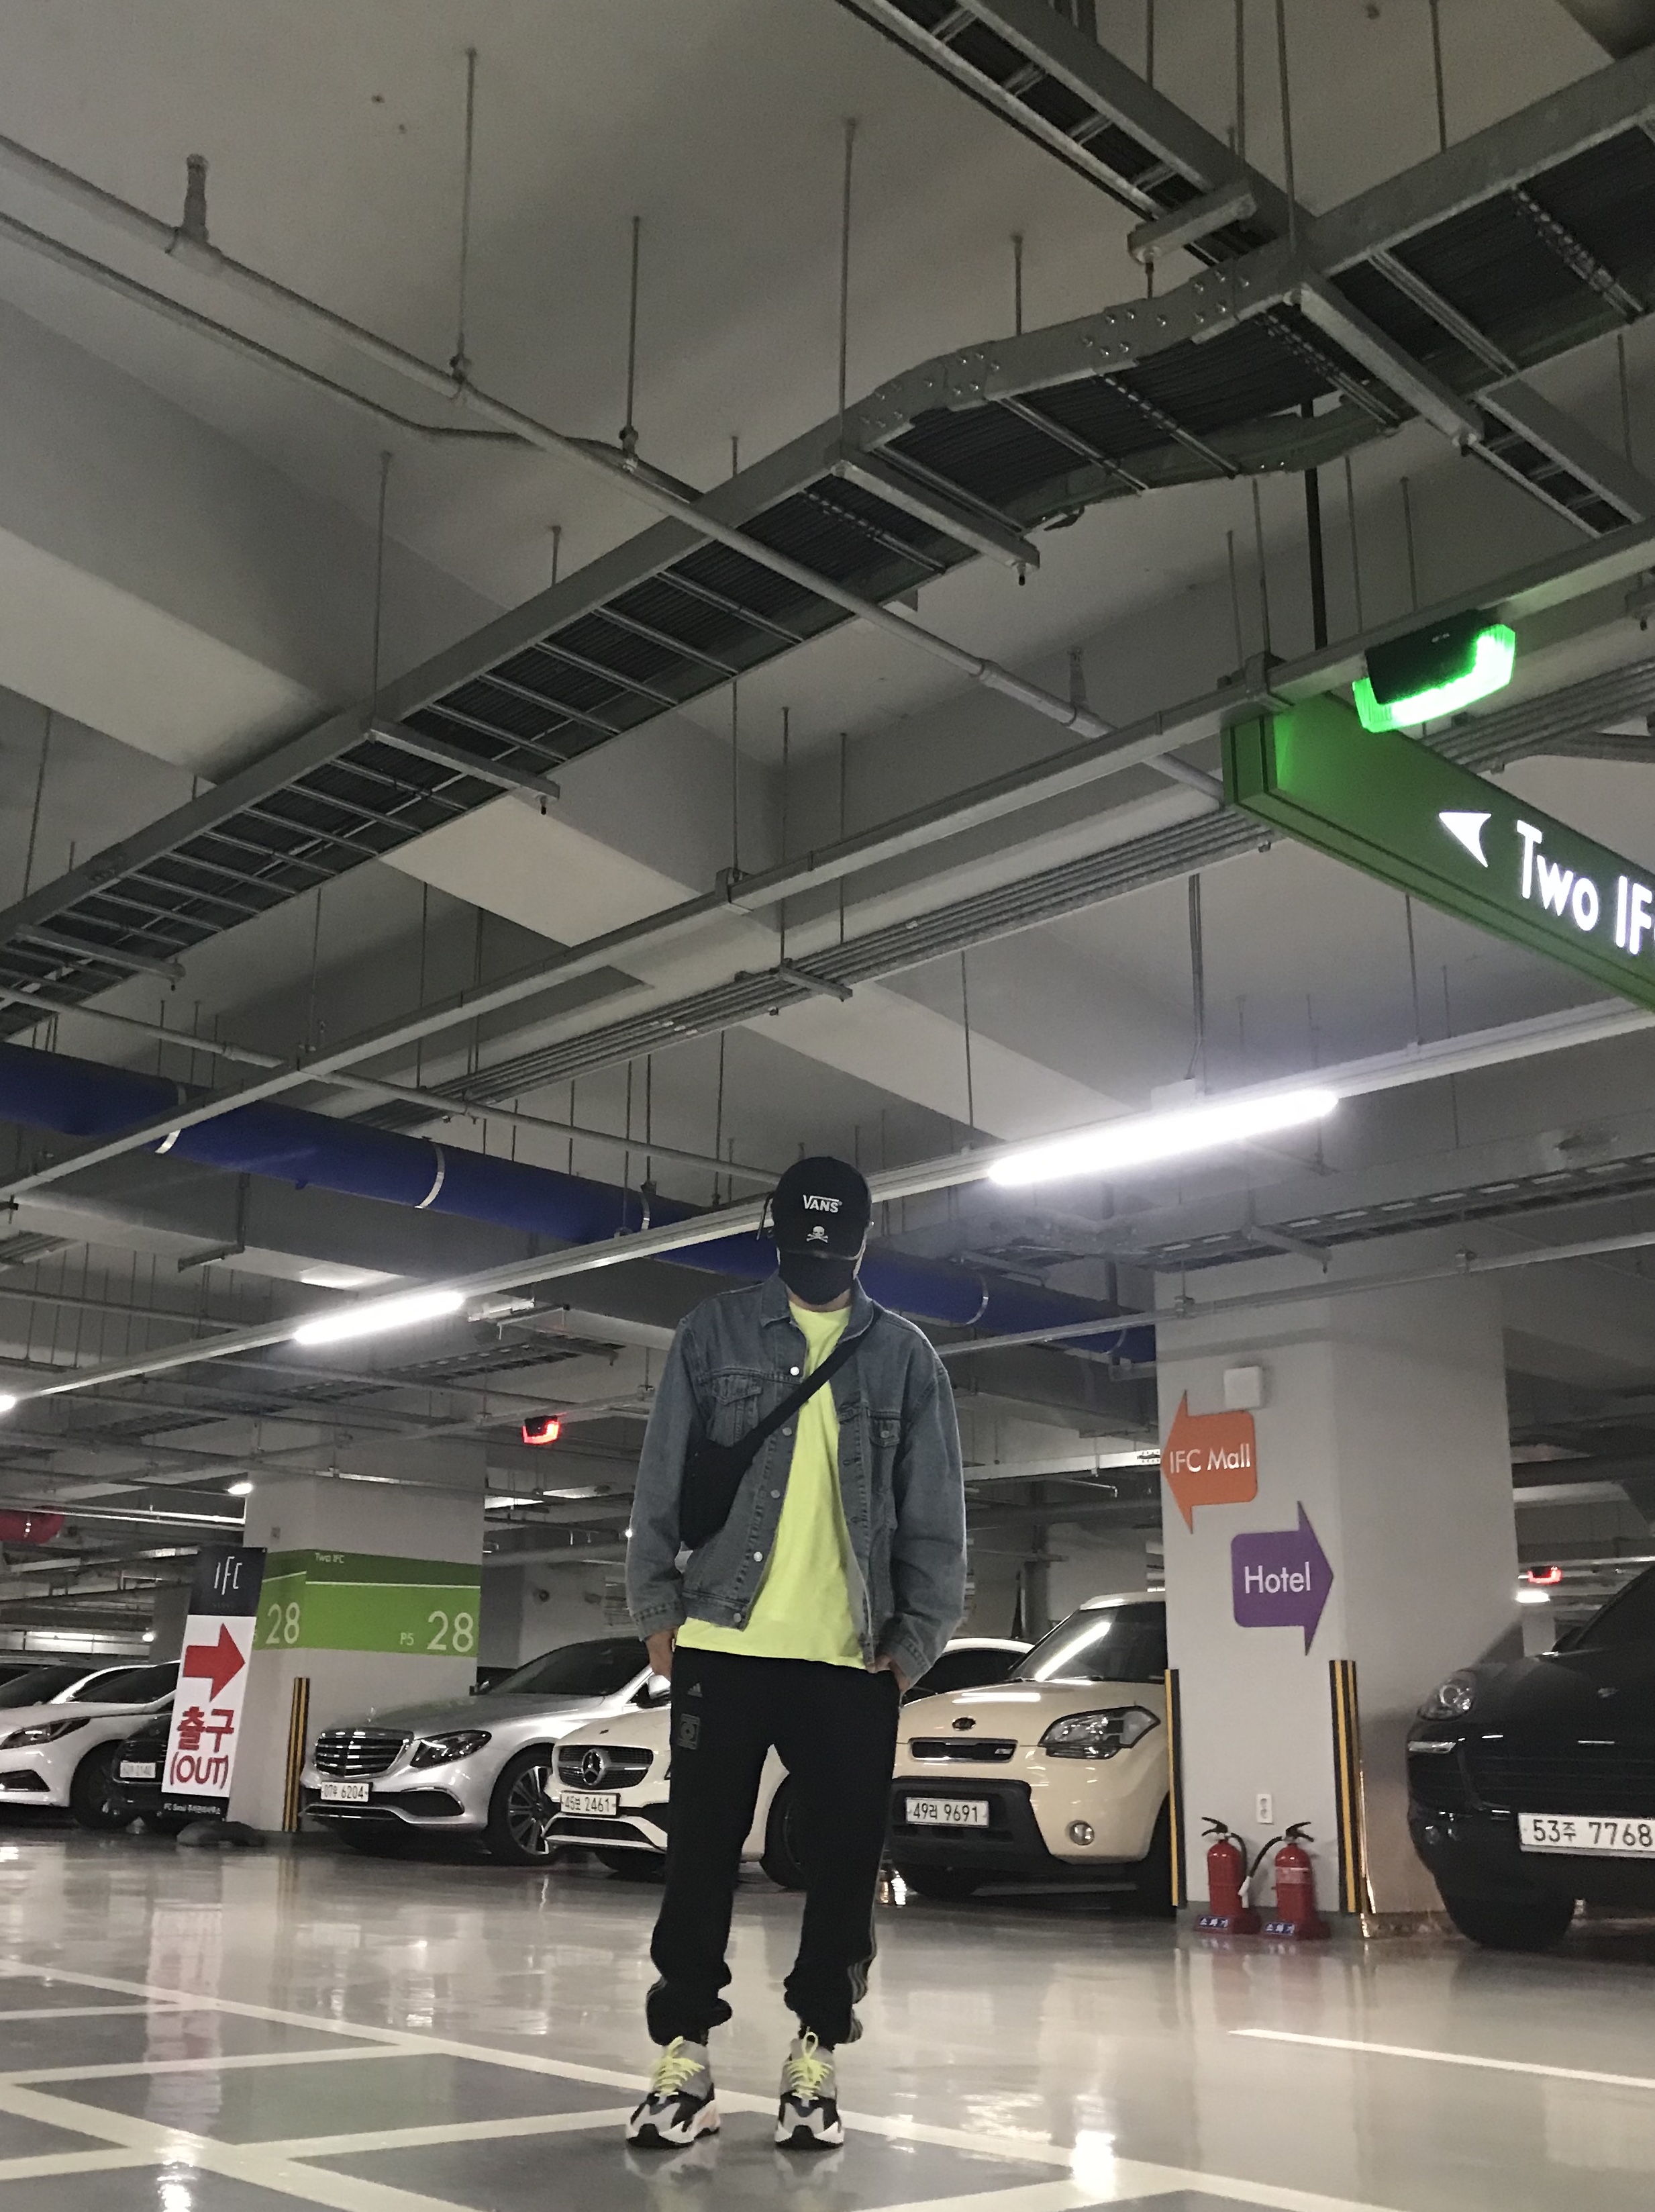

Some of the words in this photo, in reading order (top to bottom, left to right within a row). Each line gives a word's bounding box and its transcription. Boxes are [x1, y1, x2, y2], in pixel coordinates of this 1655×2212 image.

[1517, 820, 1599, 931] Two
[1616, 875, 1655, 955] IF
[803, 1194, 839, 1213] VANS
[1170, 1449, 1201, 1474] IFC
[1207, 1443, 1250, 1471] Mall
[315, 1552, 331, 1563] Two
[333, 1554, 344, 1564] IFC
[214, 1556, 242, 1595] IFC
[1244, 1561, 1311, 1594] Hotel
[265, 1602, 300, 1644] 28
[399, 1632, 414, 1646] P5
[427, 1610, 473, 1653] 28
[177, 1706, 234, 1753] 출구
[170, 1751, 228, 1790] (OUT)
[341, 1785, 364, 1799] 6204
[585, 1796, 609, 1812] 2461
[944, 1804, 978, 1822] 9691
[1533, 1819, 1576, 1842] 53주
[1589, 1821, 1653, 1847] 7768
